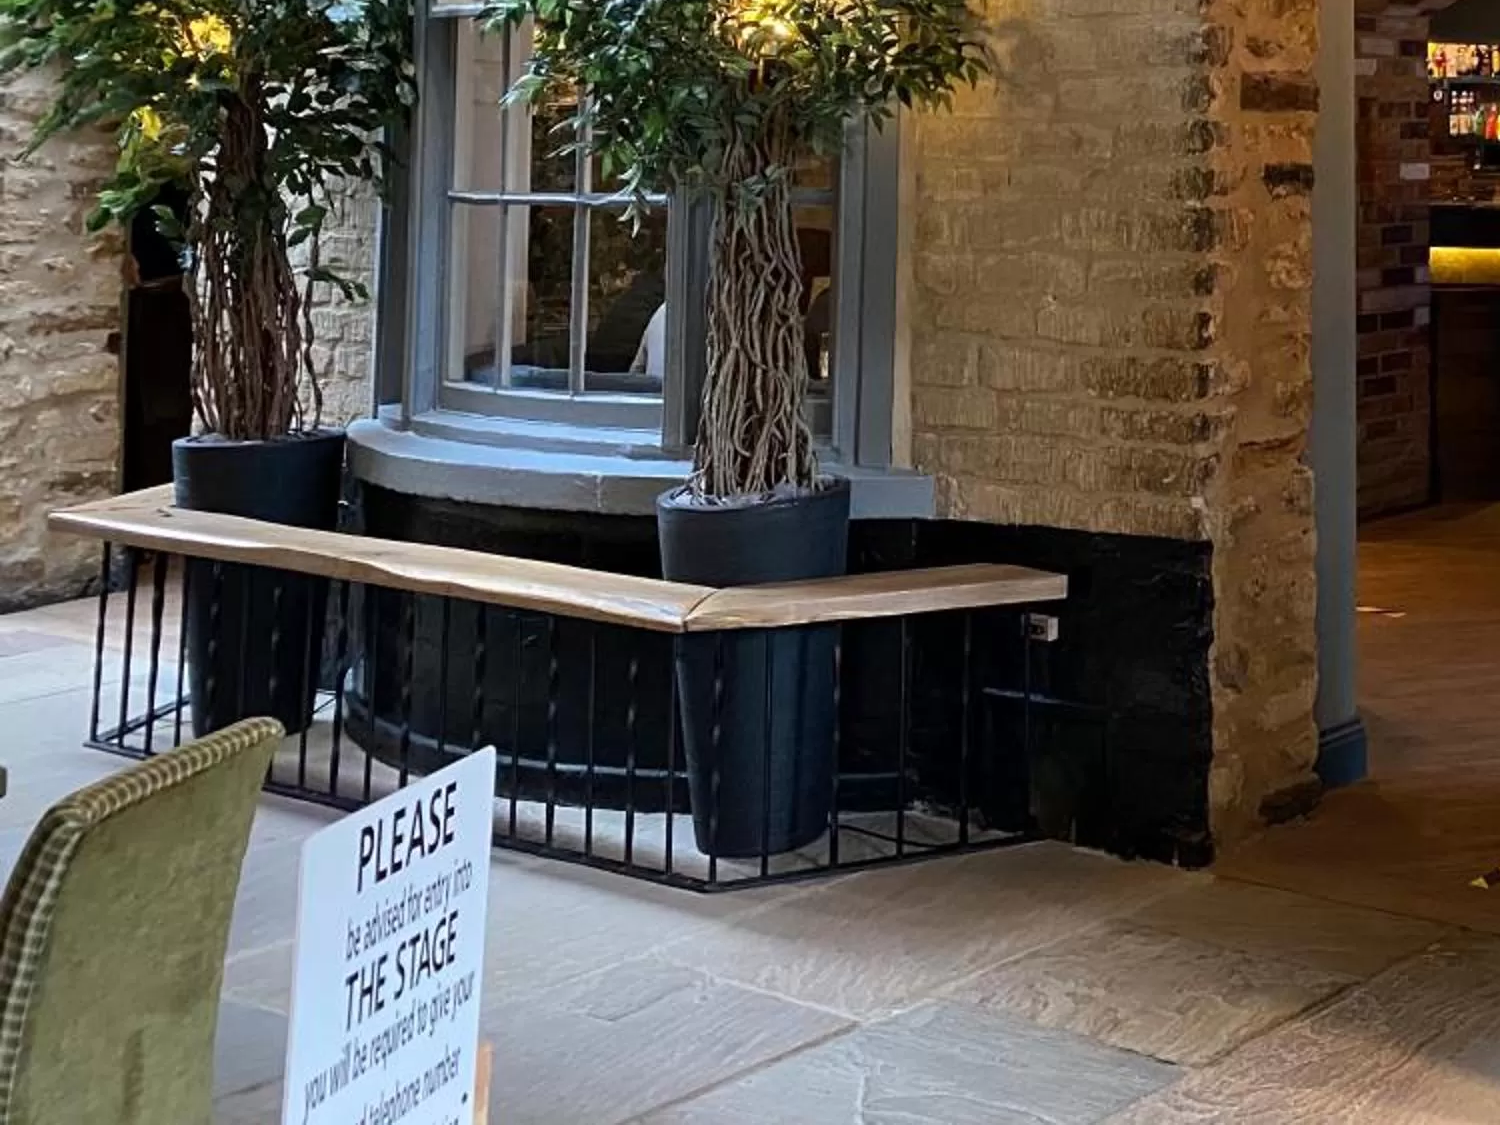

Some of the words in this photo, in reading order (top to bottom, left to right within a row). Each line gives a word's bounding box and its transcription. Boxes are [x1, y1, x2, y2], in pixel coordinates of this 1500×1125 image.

[357, 781, 457, 894] PLEASE
[346, 916, 362, 961] be
[363, 886, 405, 951] advised
[406, 881, 423, 923] for
[423, 874, 451, 914] entry
[452, 858, 473, 897] into
[346, 952, 388, 1032] THE
[394, 909, 459, 1001] STAGE
[303, 1069, 327, 1123] you
[330, 1038, 350, 1097] will
[352, 1036, 368, 1080] be
[370, 998, 416, 1071] required
[417, 998, 428, 1035] to
[429, 981, 451, 1037] give
[451, 971, 475, 1022] your
[422, 1043, 462, 1101] number
